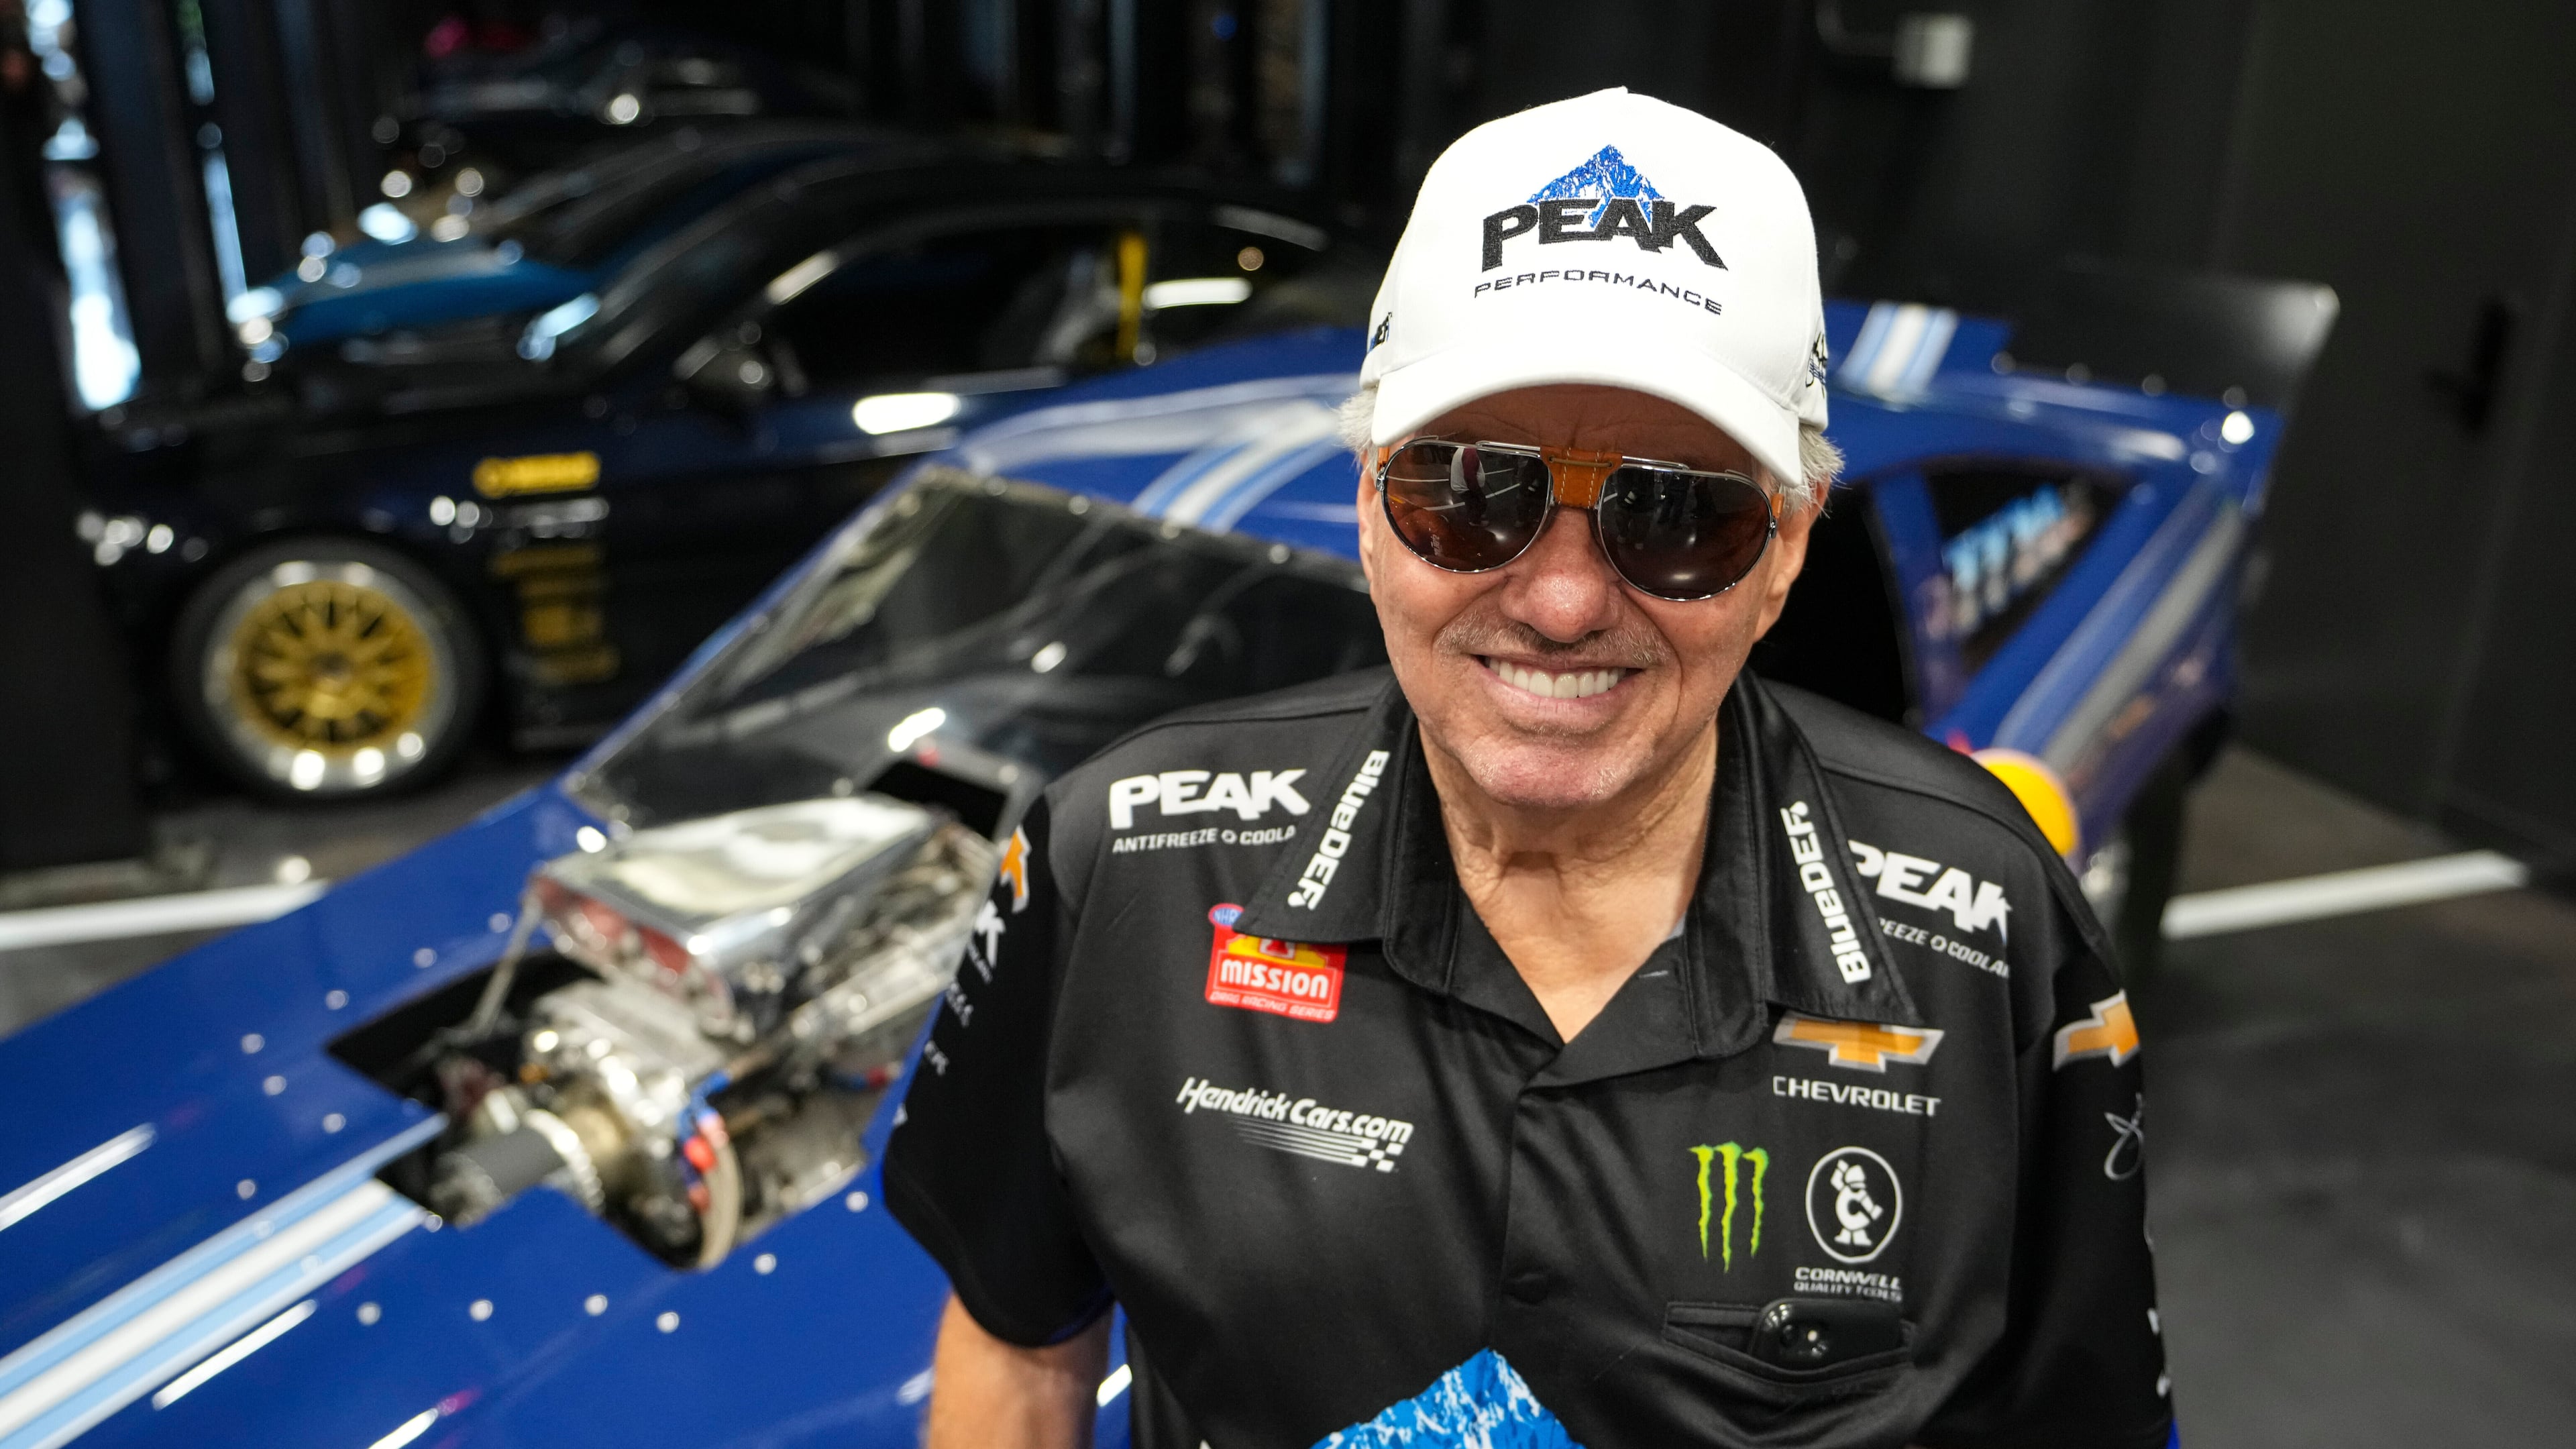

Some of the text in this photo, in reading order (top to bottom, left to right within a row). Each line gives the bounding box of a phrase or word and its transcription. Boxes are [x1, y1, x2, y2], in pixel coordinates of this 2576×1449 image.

[1481, 198, 1729, 272] PEAK
[1474, 270, 1723, 316] PERFORMANCE
[1109, 768, 1311, 830] PEAK
[1112, 824, 1296, 854] ANTIFREEZE COOLA
[1214, 908, 1240, 924] NHR
[1879, 917, 1929, 946] EEZE
[1220, 959, 1330, 1000] MISSION
[1241, 995, 1288, 1013] RACING
[1288, 1004, 1336, 1020] SERIES
[1772, 1075, 1941, 1117] CHEVROLET
[1793, 1281, 1903, 1303] QUALITY TOOLS
[1794, 1266, 1900, 1291] CORNWELL
